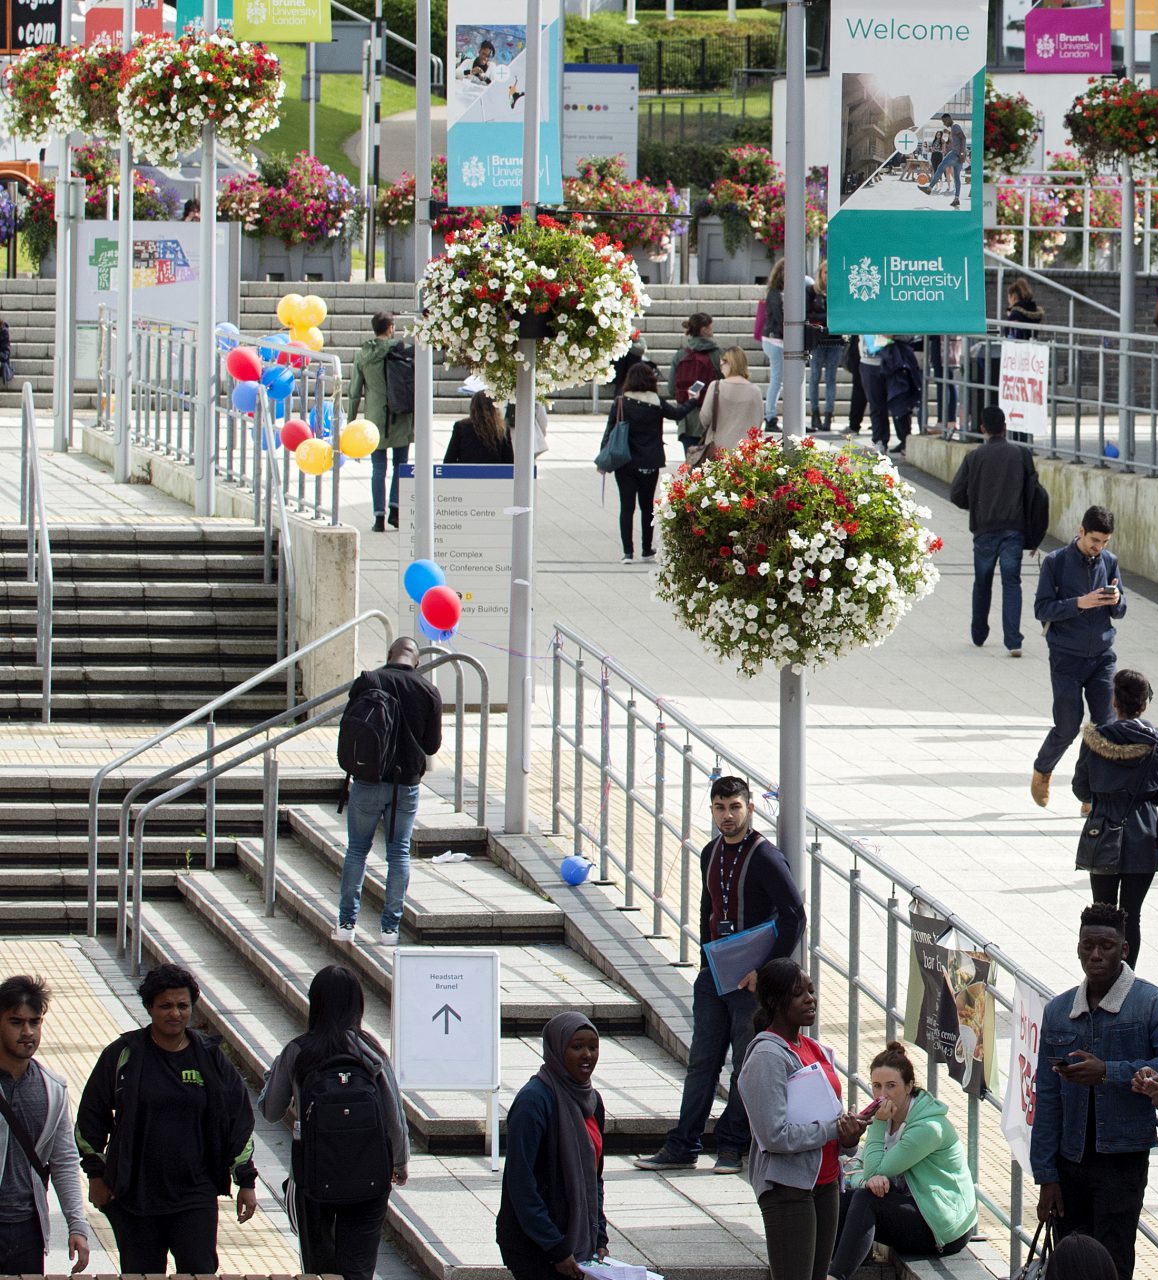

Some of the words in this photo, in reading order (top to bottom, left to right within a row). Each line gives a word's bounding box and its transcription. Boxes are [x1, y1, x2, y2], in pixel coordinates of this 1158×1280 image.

[272, 6, 318, 18] University
[272, 16, 306, 25] London
[846, 18, 970, 41] Welcome
[1059, 33, 1089, 42] Brunel
[1059, 41, 1099, 52] University
[1059, 50, 1089, 59] London
[492, 176, 523, 187] Londo
[890, 256, 944, 271] Brunel
[890, 272, 962, 290] University
[891, 287, 945, 301] London
[437, 495, 463, 503] Centre
[435, 509, 469, 517] Athletics
[470, 509, 496, 518] Centre
[449, 550, 483, 560] Complex
[449, 564, 494, 572] Conference
[477, 604, 509, 614] Building
[430, 973, 464, 981] Headstart
